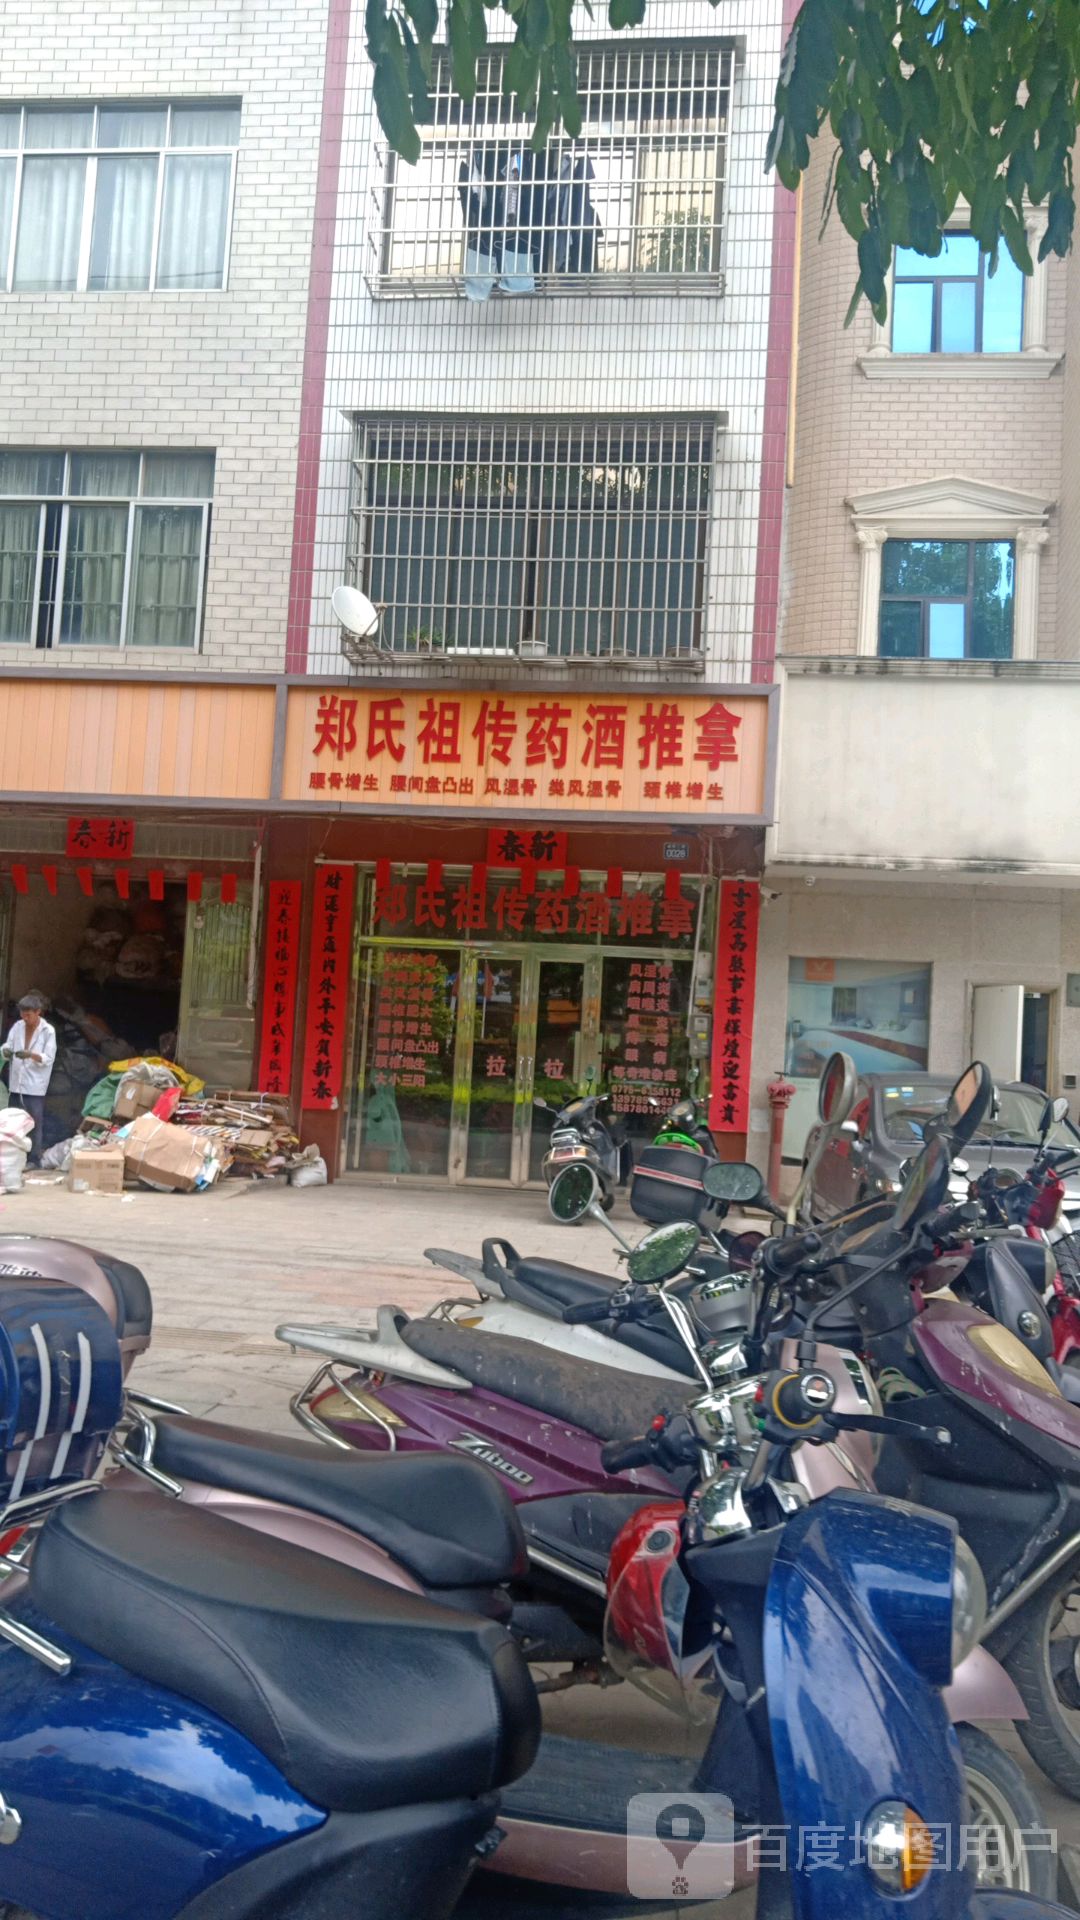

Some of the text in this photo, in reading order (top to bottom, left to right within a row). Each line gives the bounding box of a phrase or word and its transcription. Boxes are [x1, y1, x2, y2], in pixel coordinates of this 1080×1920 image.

[312, 694, 742, 771] 郑氏祖传药酒推拿
[309, 772, 379, 791] 腰骨增生
[390, 775, 474, 795] 腰间盘凸出
[643, 780, 724, 801] 颈椎增生
[372, 884, 694, 938] 郑氏祖传药酒推拿
[628, 980, 671, 995] 肩周炎
[627, 996, 670, 1012] 咽喉炎
[486, 1055, 506, 1077] 拉
[544, 1058, 565, 1079] 拉
[375, 1072, 426, 1088] 大小三阳
[448, 1432, 534, 1484] Zuboo
